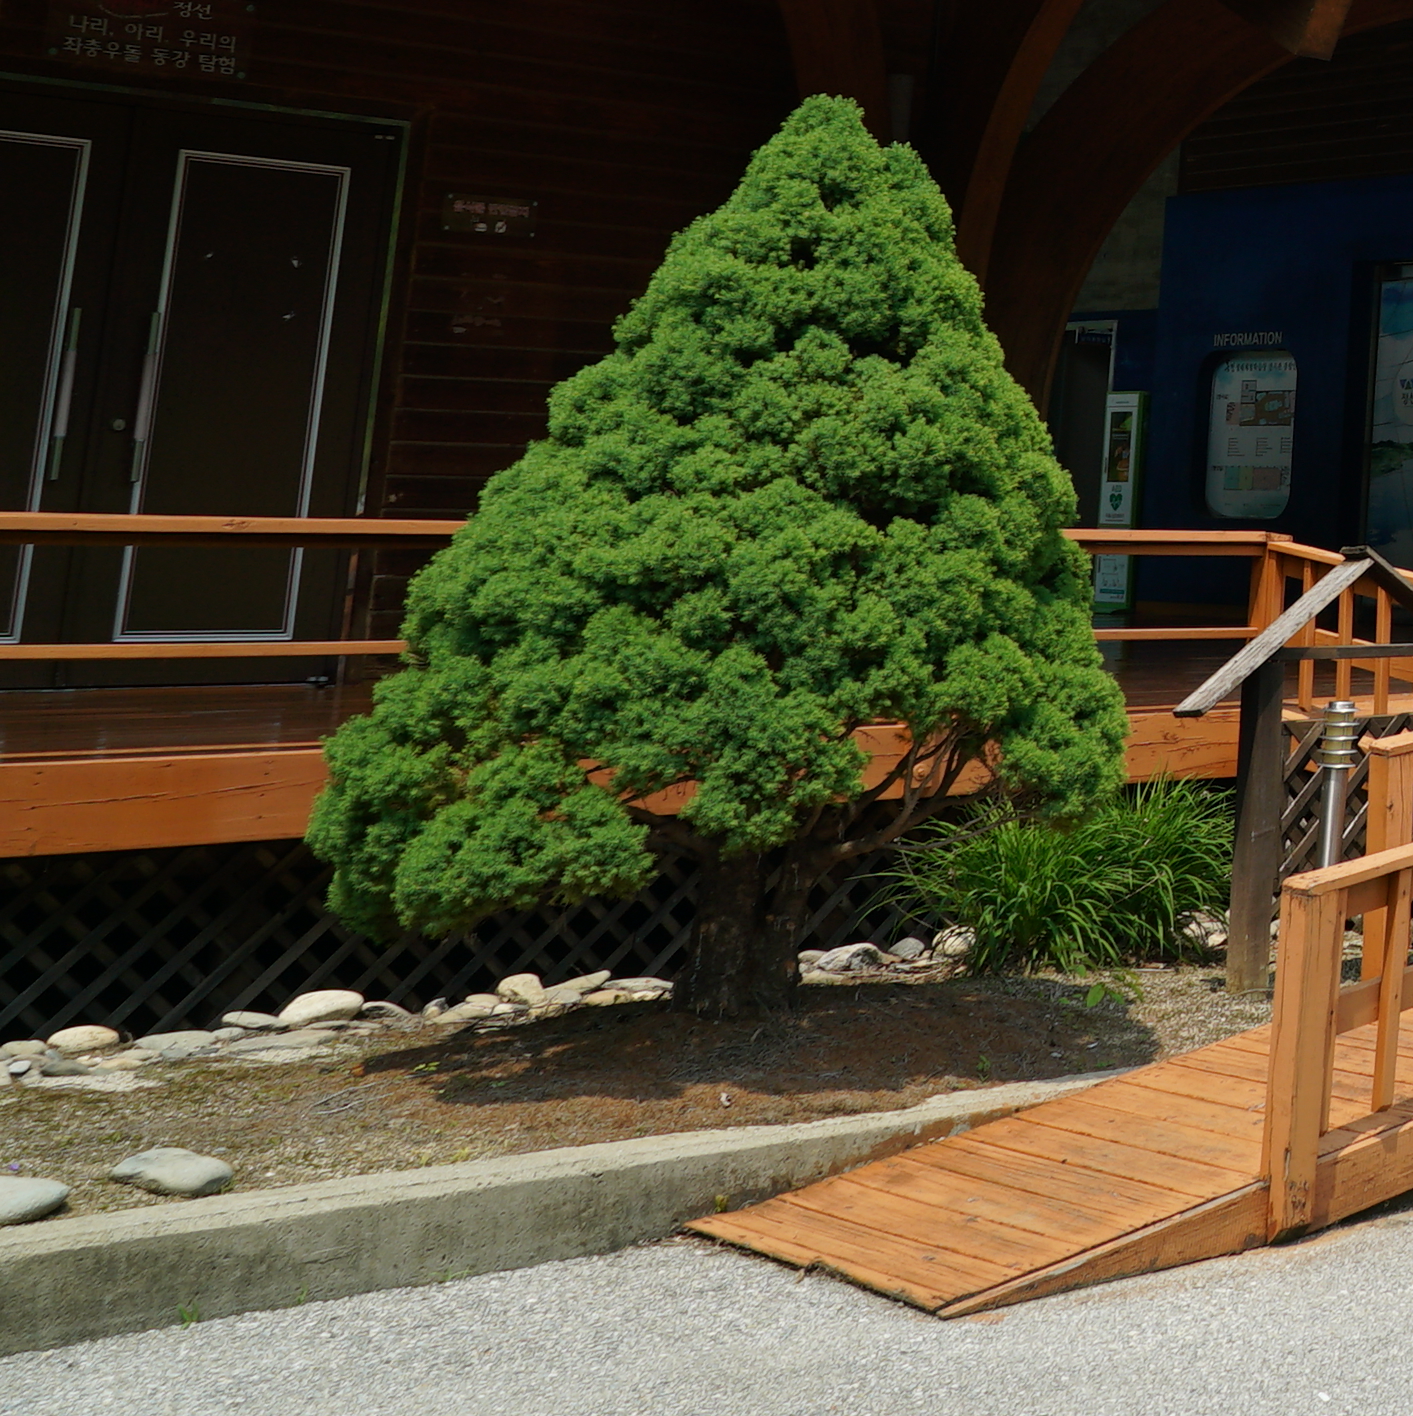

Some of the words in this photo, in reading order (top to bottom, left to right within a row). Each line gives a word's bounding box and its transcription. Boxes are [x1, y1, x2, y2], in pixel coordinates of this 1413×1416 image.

[173, 1, 213, 21] 정선
[179, 29, 237, 54] 우리의
[62, 35, 142, 64] 좌충우돌
[150, 47, 191, 69] 동강
[198, 53, 237, 76] 탐험
[1213, 331, 1283, 347] INFORMATION
